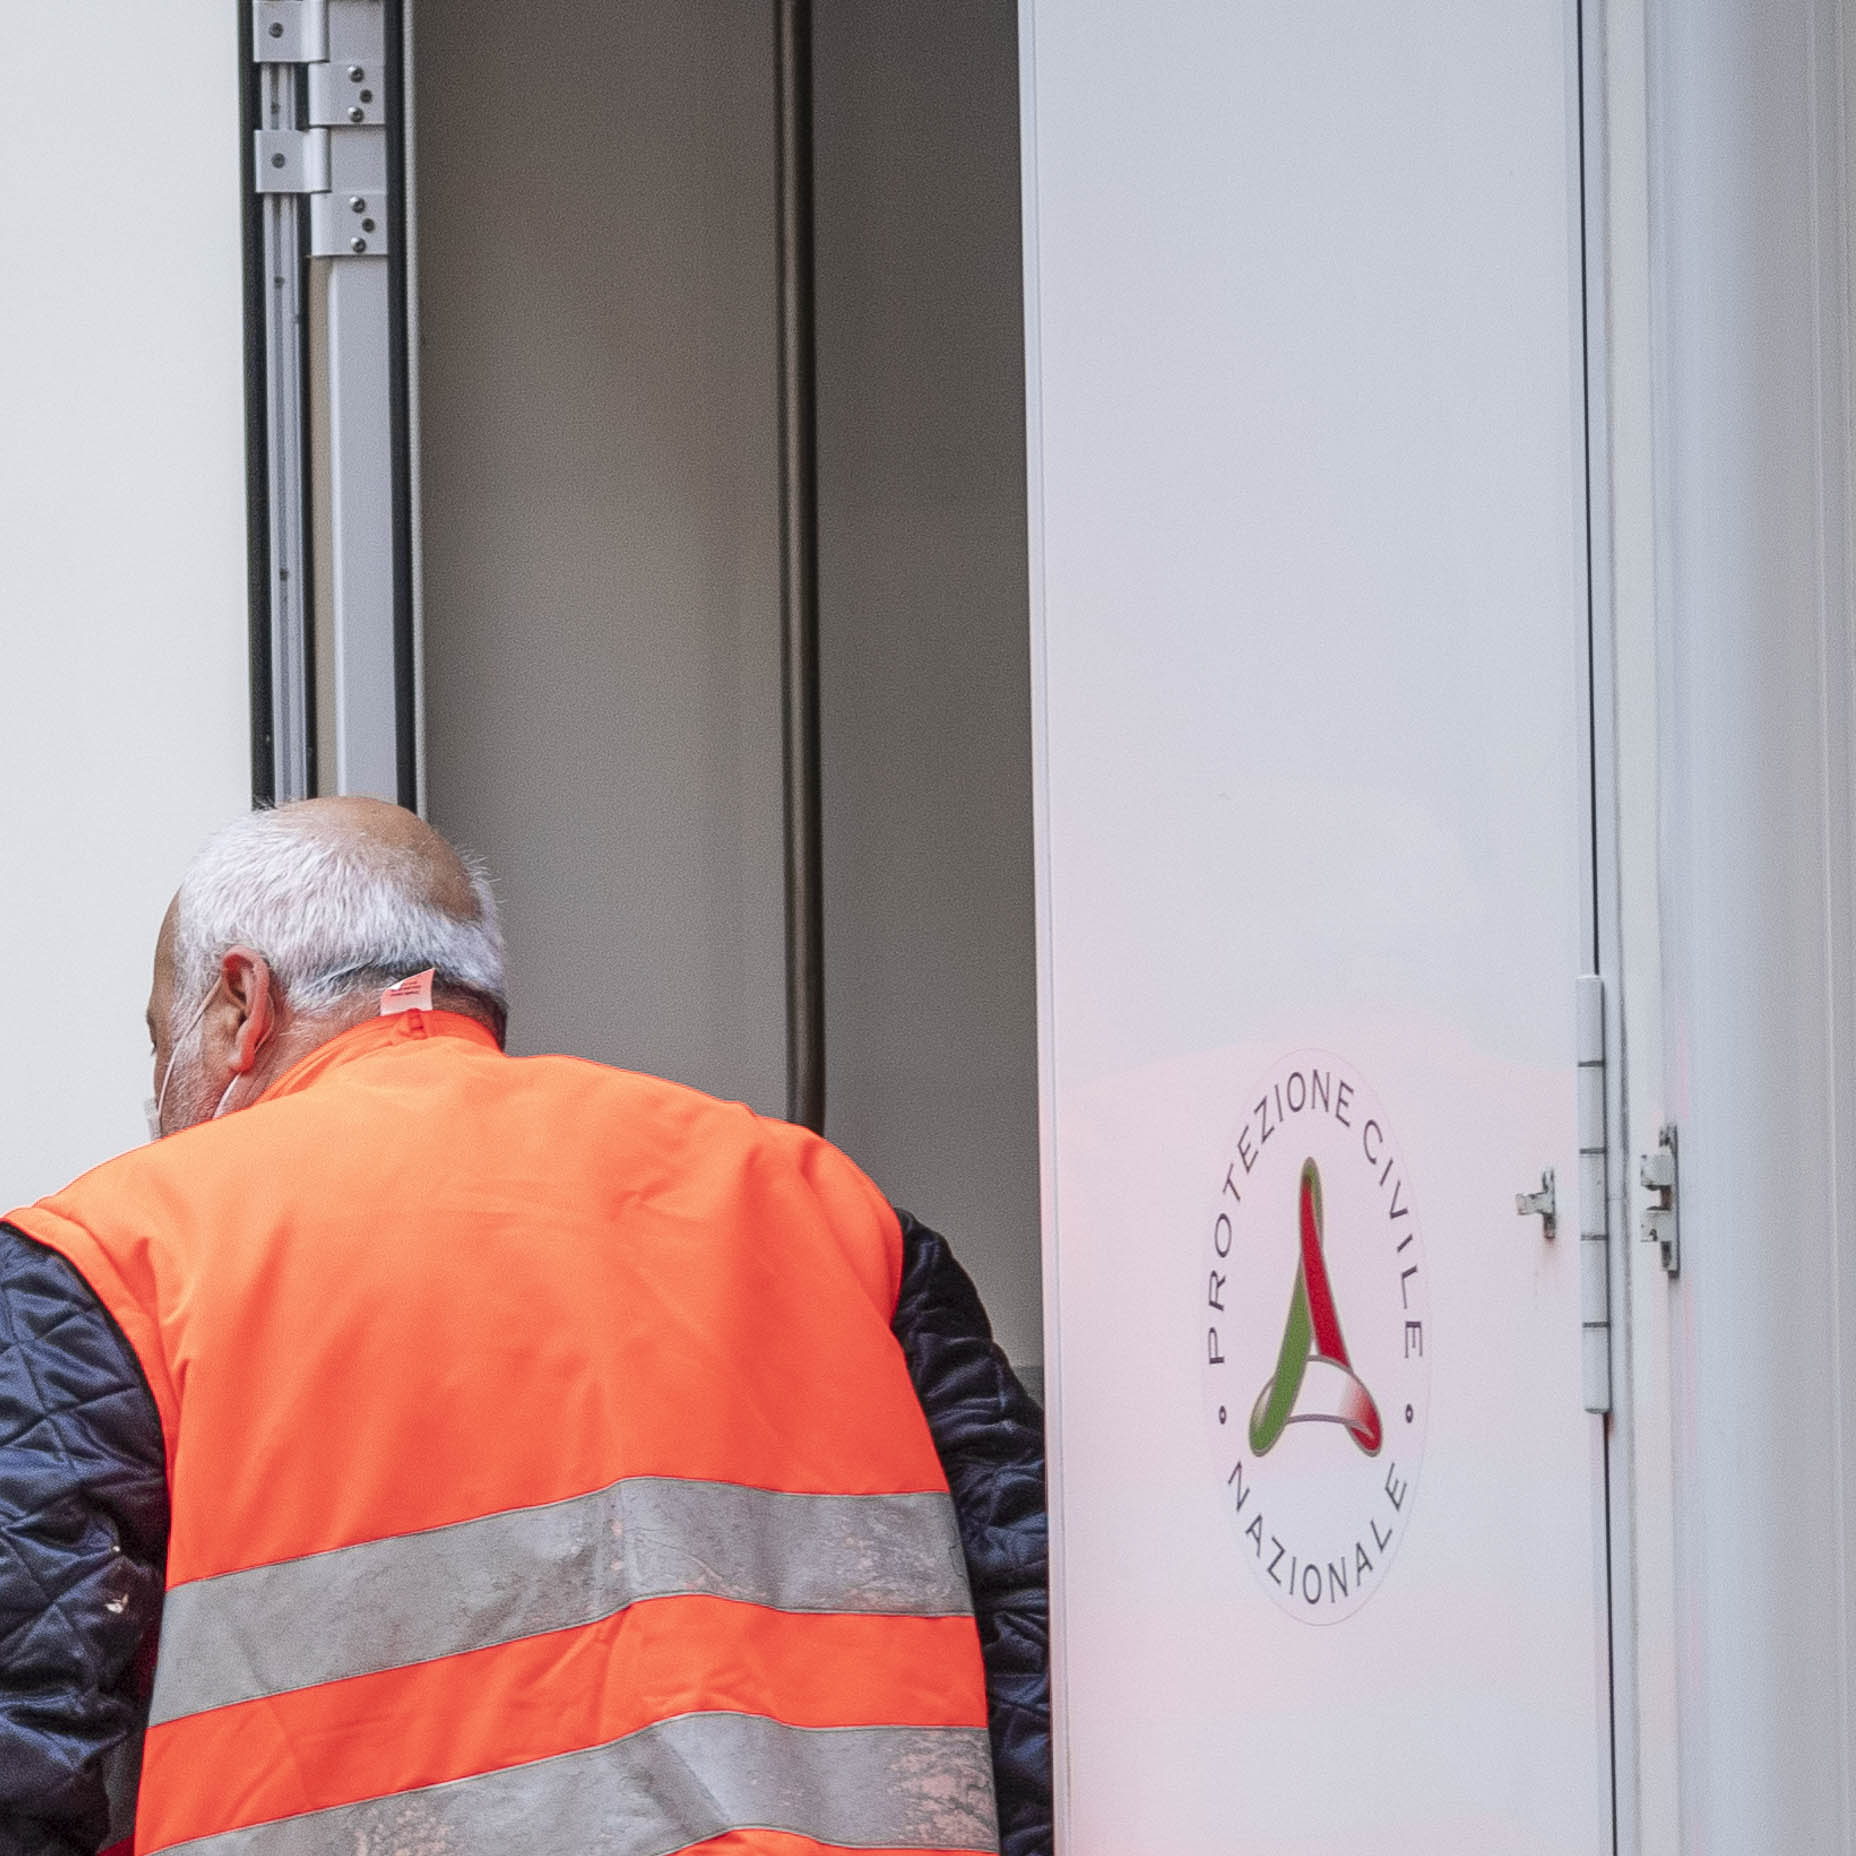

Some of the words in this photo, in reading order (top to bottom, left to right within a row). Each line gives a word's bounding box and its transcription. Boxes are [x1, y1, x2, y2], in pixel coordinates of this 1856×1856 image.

[1207, 1068, 1355, 1365] PROTEZIONE
[1362, 1119, 1424, 1359] CIVILE
[1228, 1460, 1408, 1605] NAZIONALE
